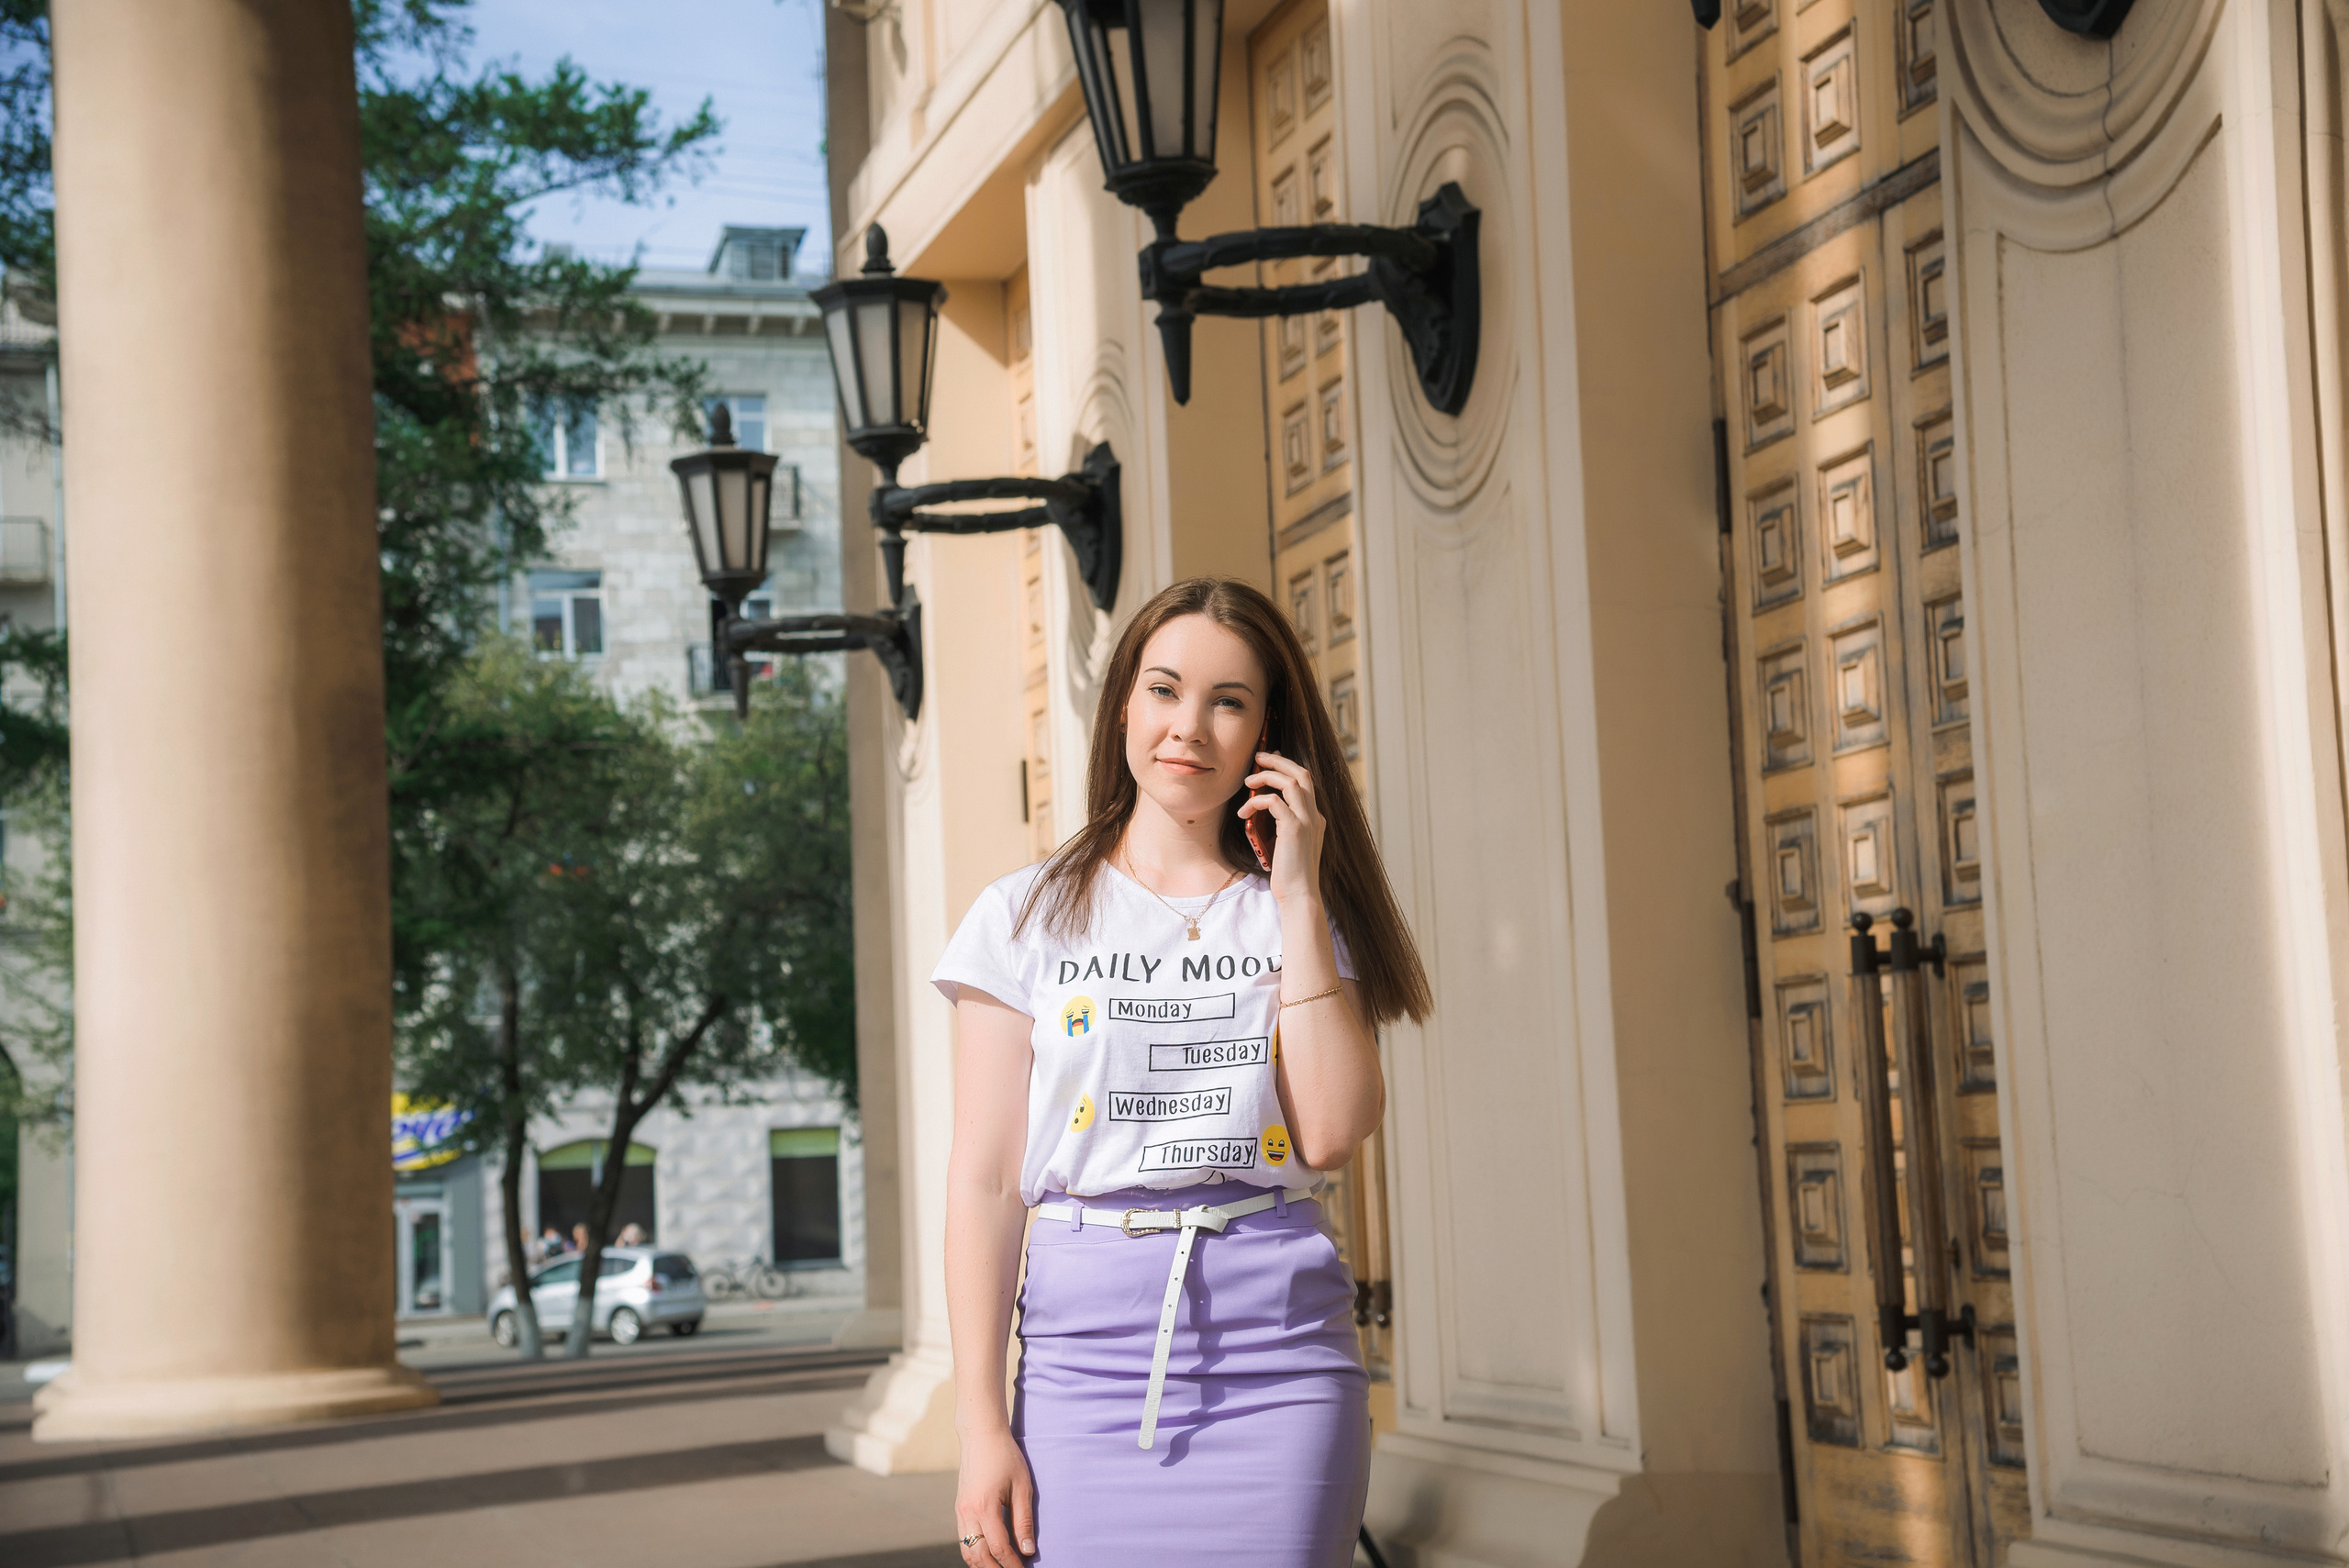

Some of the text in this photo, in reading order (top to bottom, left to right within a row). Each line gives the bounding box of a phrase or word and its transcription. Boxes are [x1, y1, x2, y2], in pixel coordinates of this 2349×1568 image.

[1058, 953, 1162, 984] DAILY
[1118, 1001, 1192, 1019] Monday
[1182, 1041, 1261, 1064] Tuesday
[1115, 1093, 1227, 1117] Wednesday
[1161, 1142, 1254, 1165] Thursday
